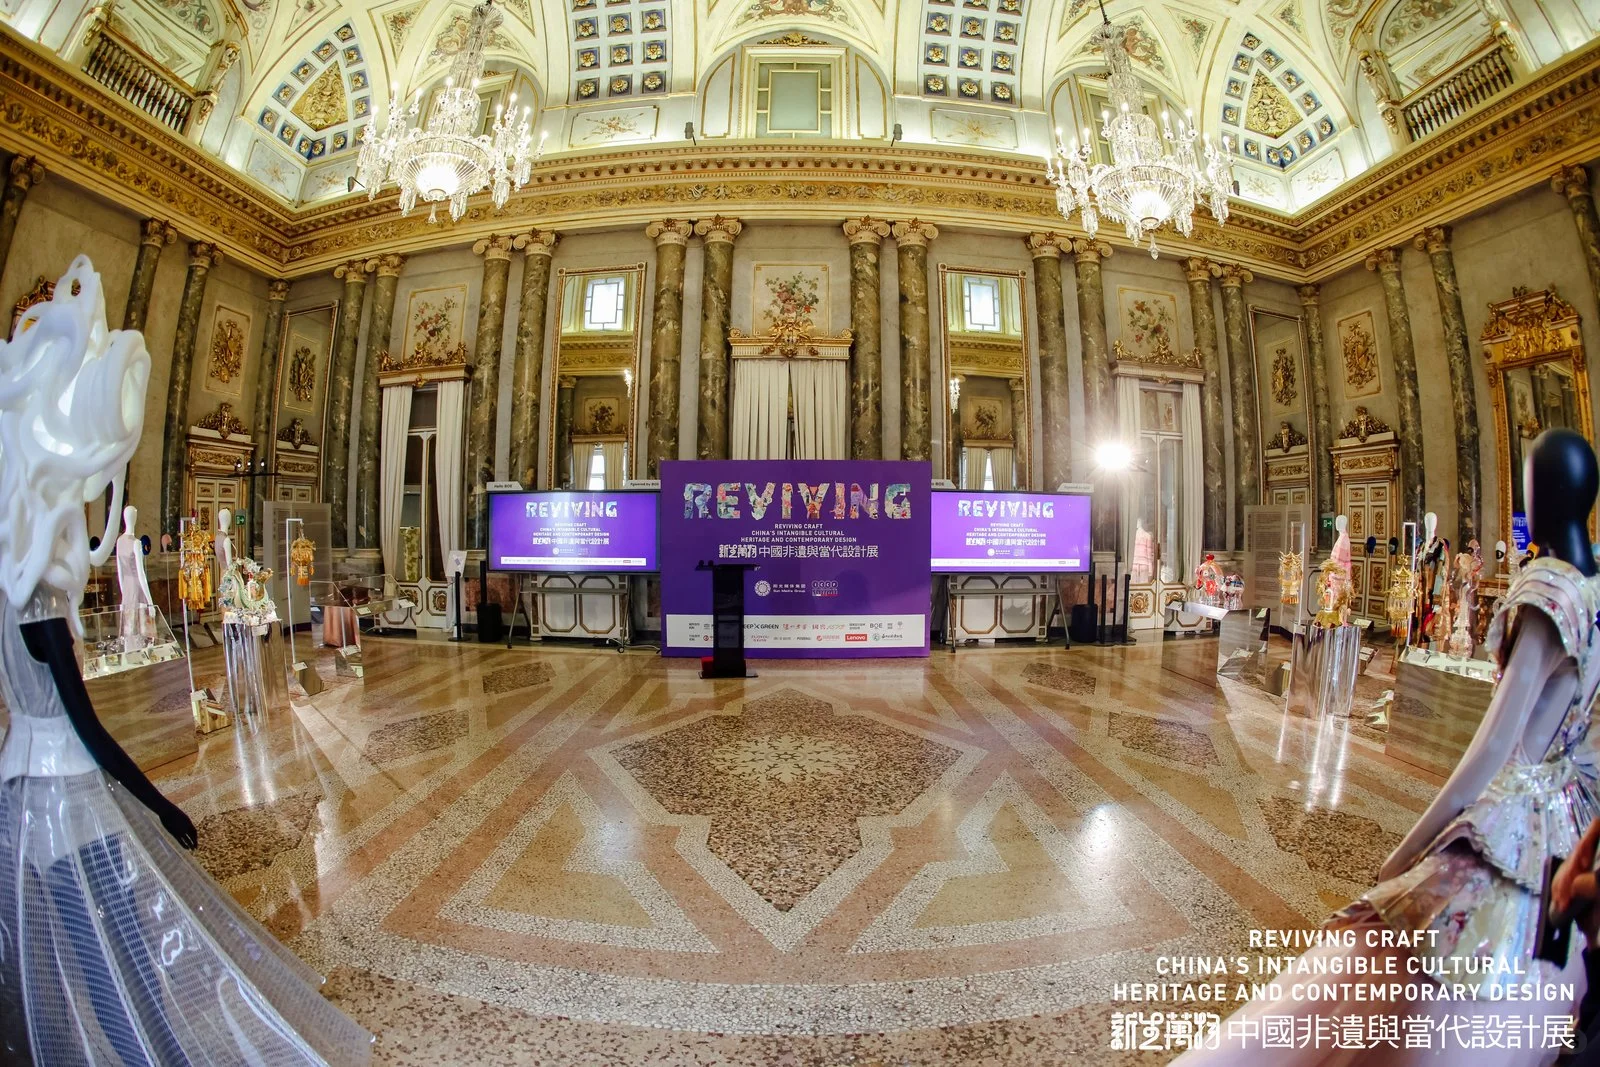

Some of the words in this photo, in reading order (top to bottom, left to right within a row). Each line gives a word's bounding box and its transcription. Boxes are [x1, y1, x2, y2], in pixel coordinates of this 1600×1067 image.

[526, 501, 617, 518] REVIVING
[683, 482, 912, 520] REVIVING
[958, 499, 1054, 519] REVIVING
[758, 545, 879, 558] 中國非遺與當代設計展
